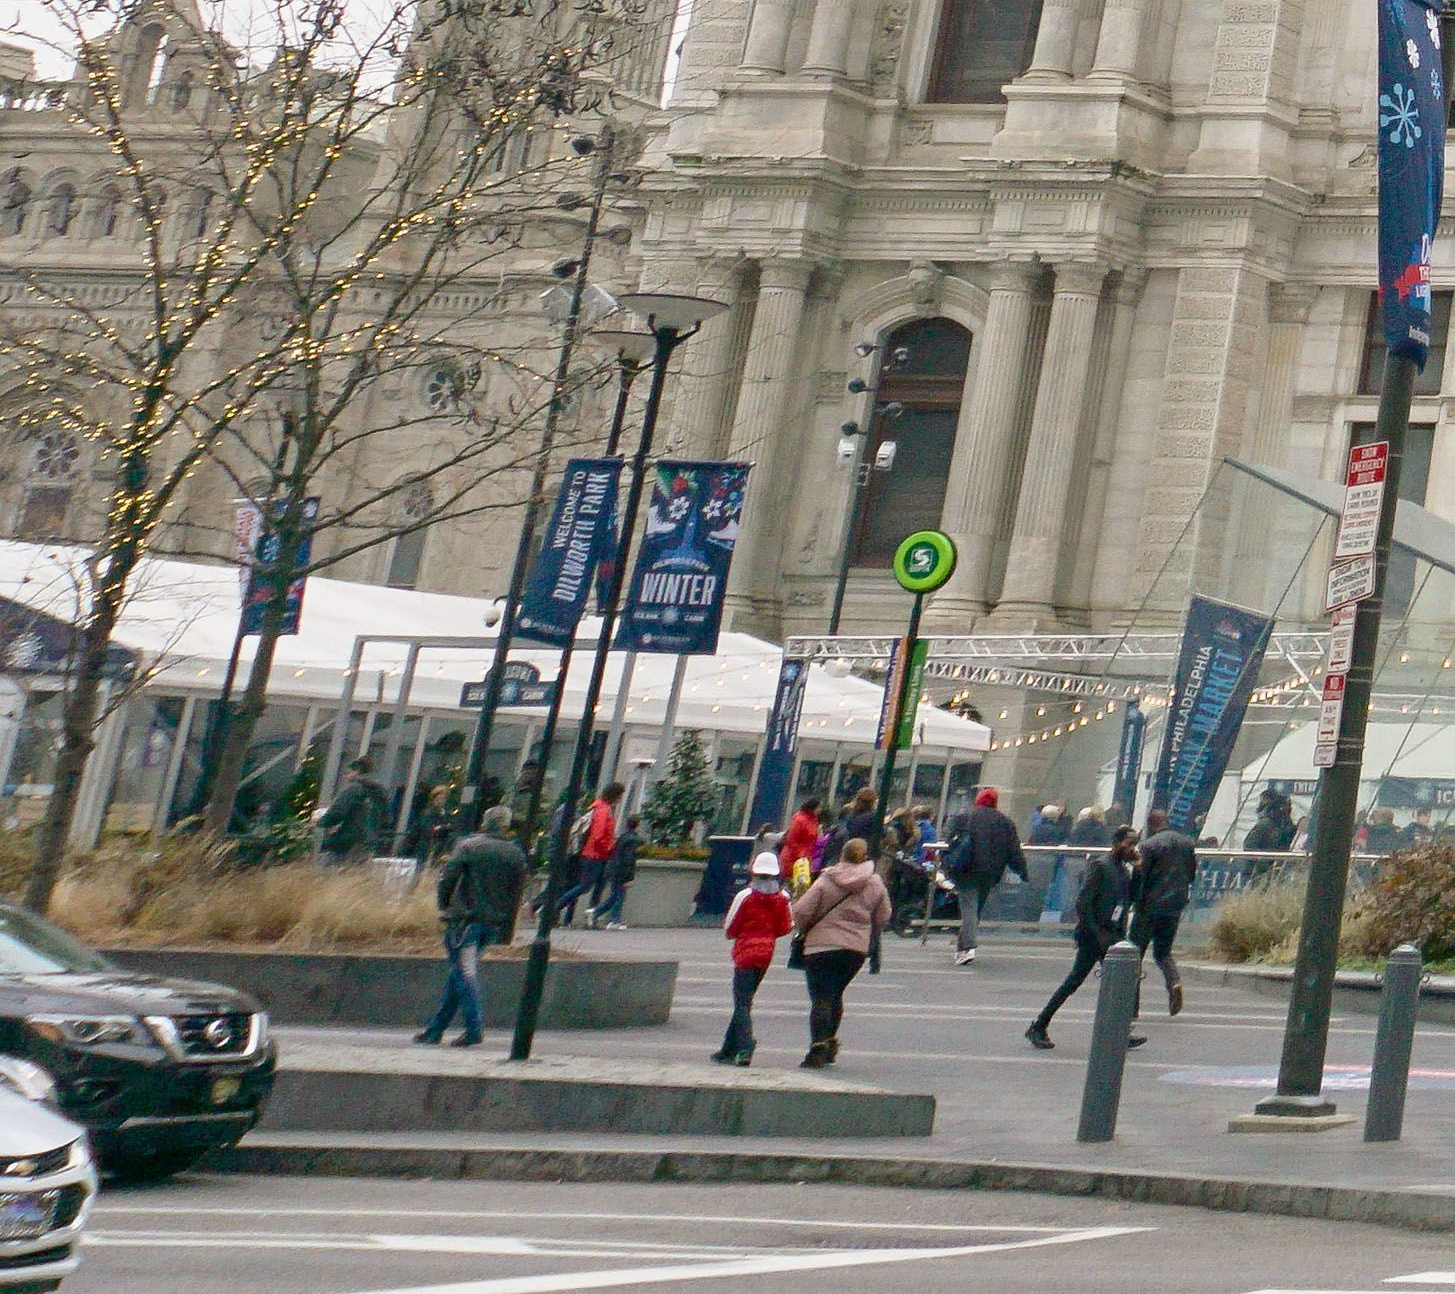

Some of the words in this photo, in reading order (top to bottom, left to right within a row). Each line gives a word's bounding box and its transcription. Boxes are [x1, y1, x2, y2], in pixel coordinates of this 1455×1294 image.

[552, 516, 596, 602] DILWORTH
[584, 472, 611, 514] PARK
[553, 488, 582, 549] WELCOME
[575, 471, 587, 486] TO
[640, 573, 716, 606] WINTER
[1169, 738, 1211, 828] HOLIDAY
[1191, 649, 1244, 735] MARKET
[1172, 645, 1213, 752] PHILADELPHIA
